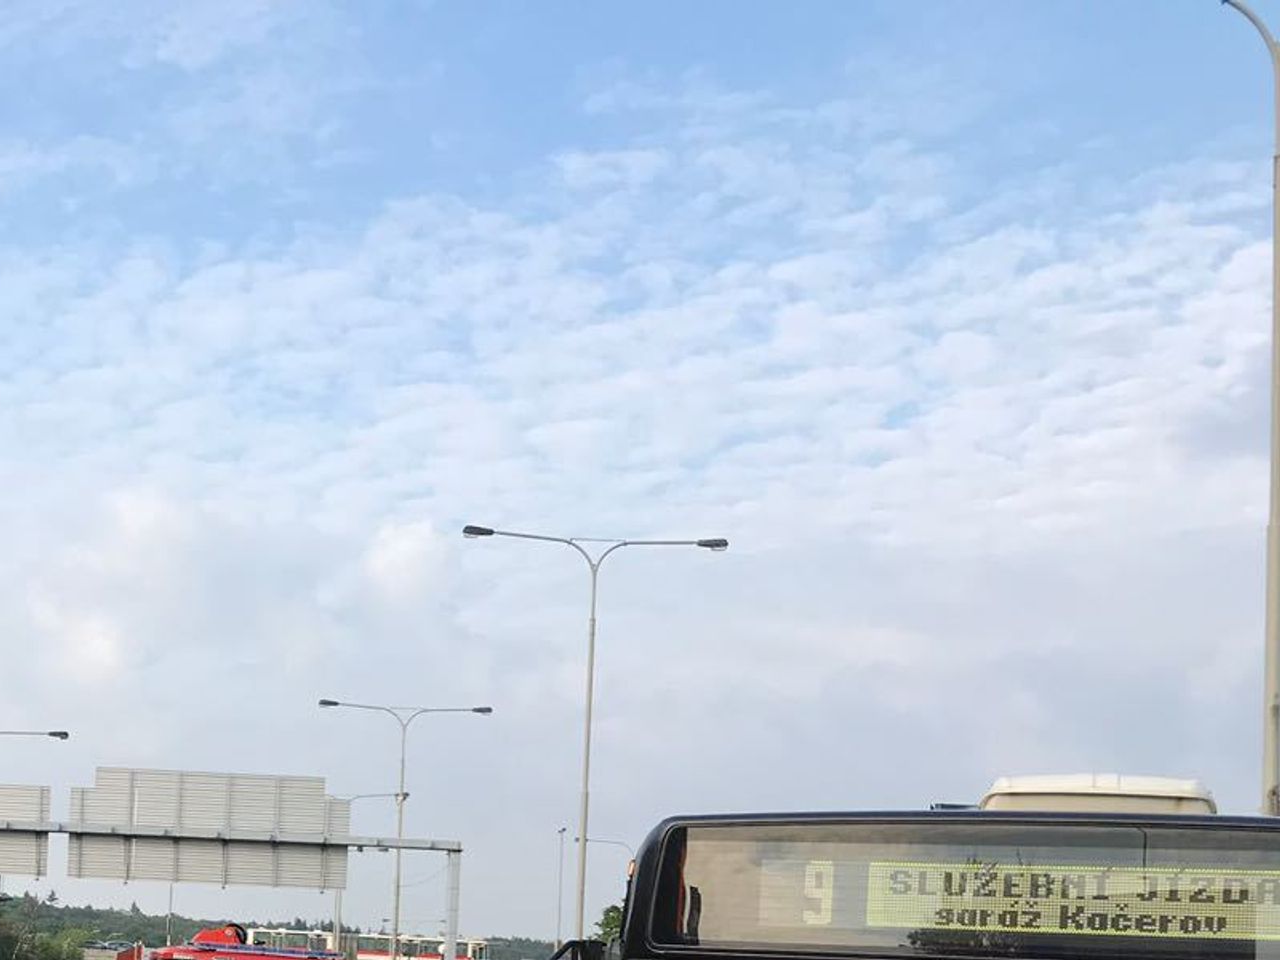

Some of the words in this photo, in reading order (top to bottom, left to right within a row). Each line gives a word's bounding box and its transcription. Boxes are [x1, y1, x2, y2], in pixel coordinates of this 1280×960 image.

[888, 864, 1109, 900] SLUŽEBNÍ
[934, 900, 1041, 928] garáž
[1059, 902, 1227, 934] Kačerov
